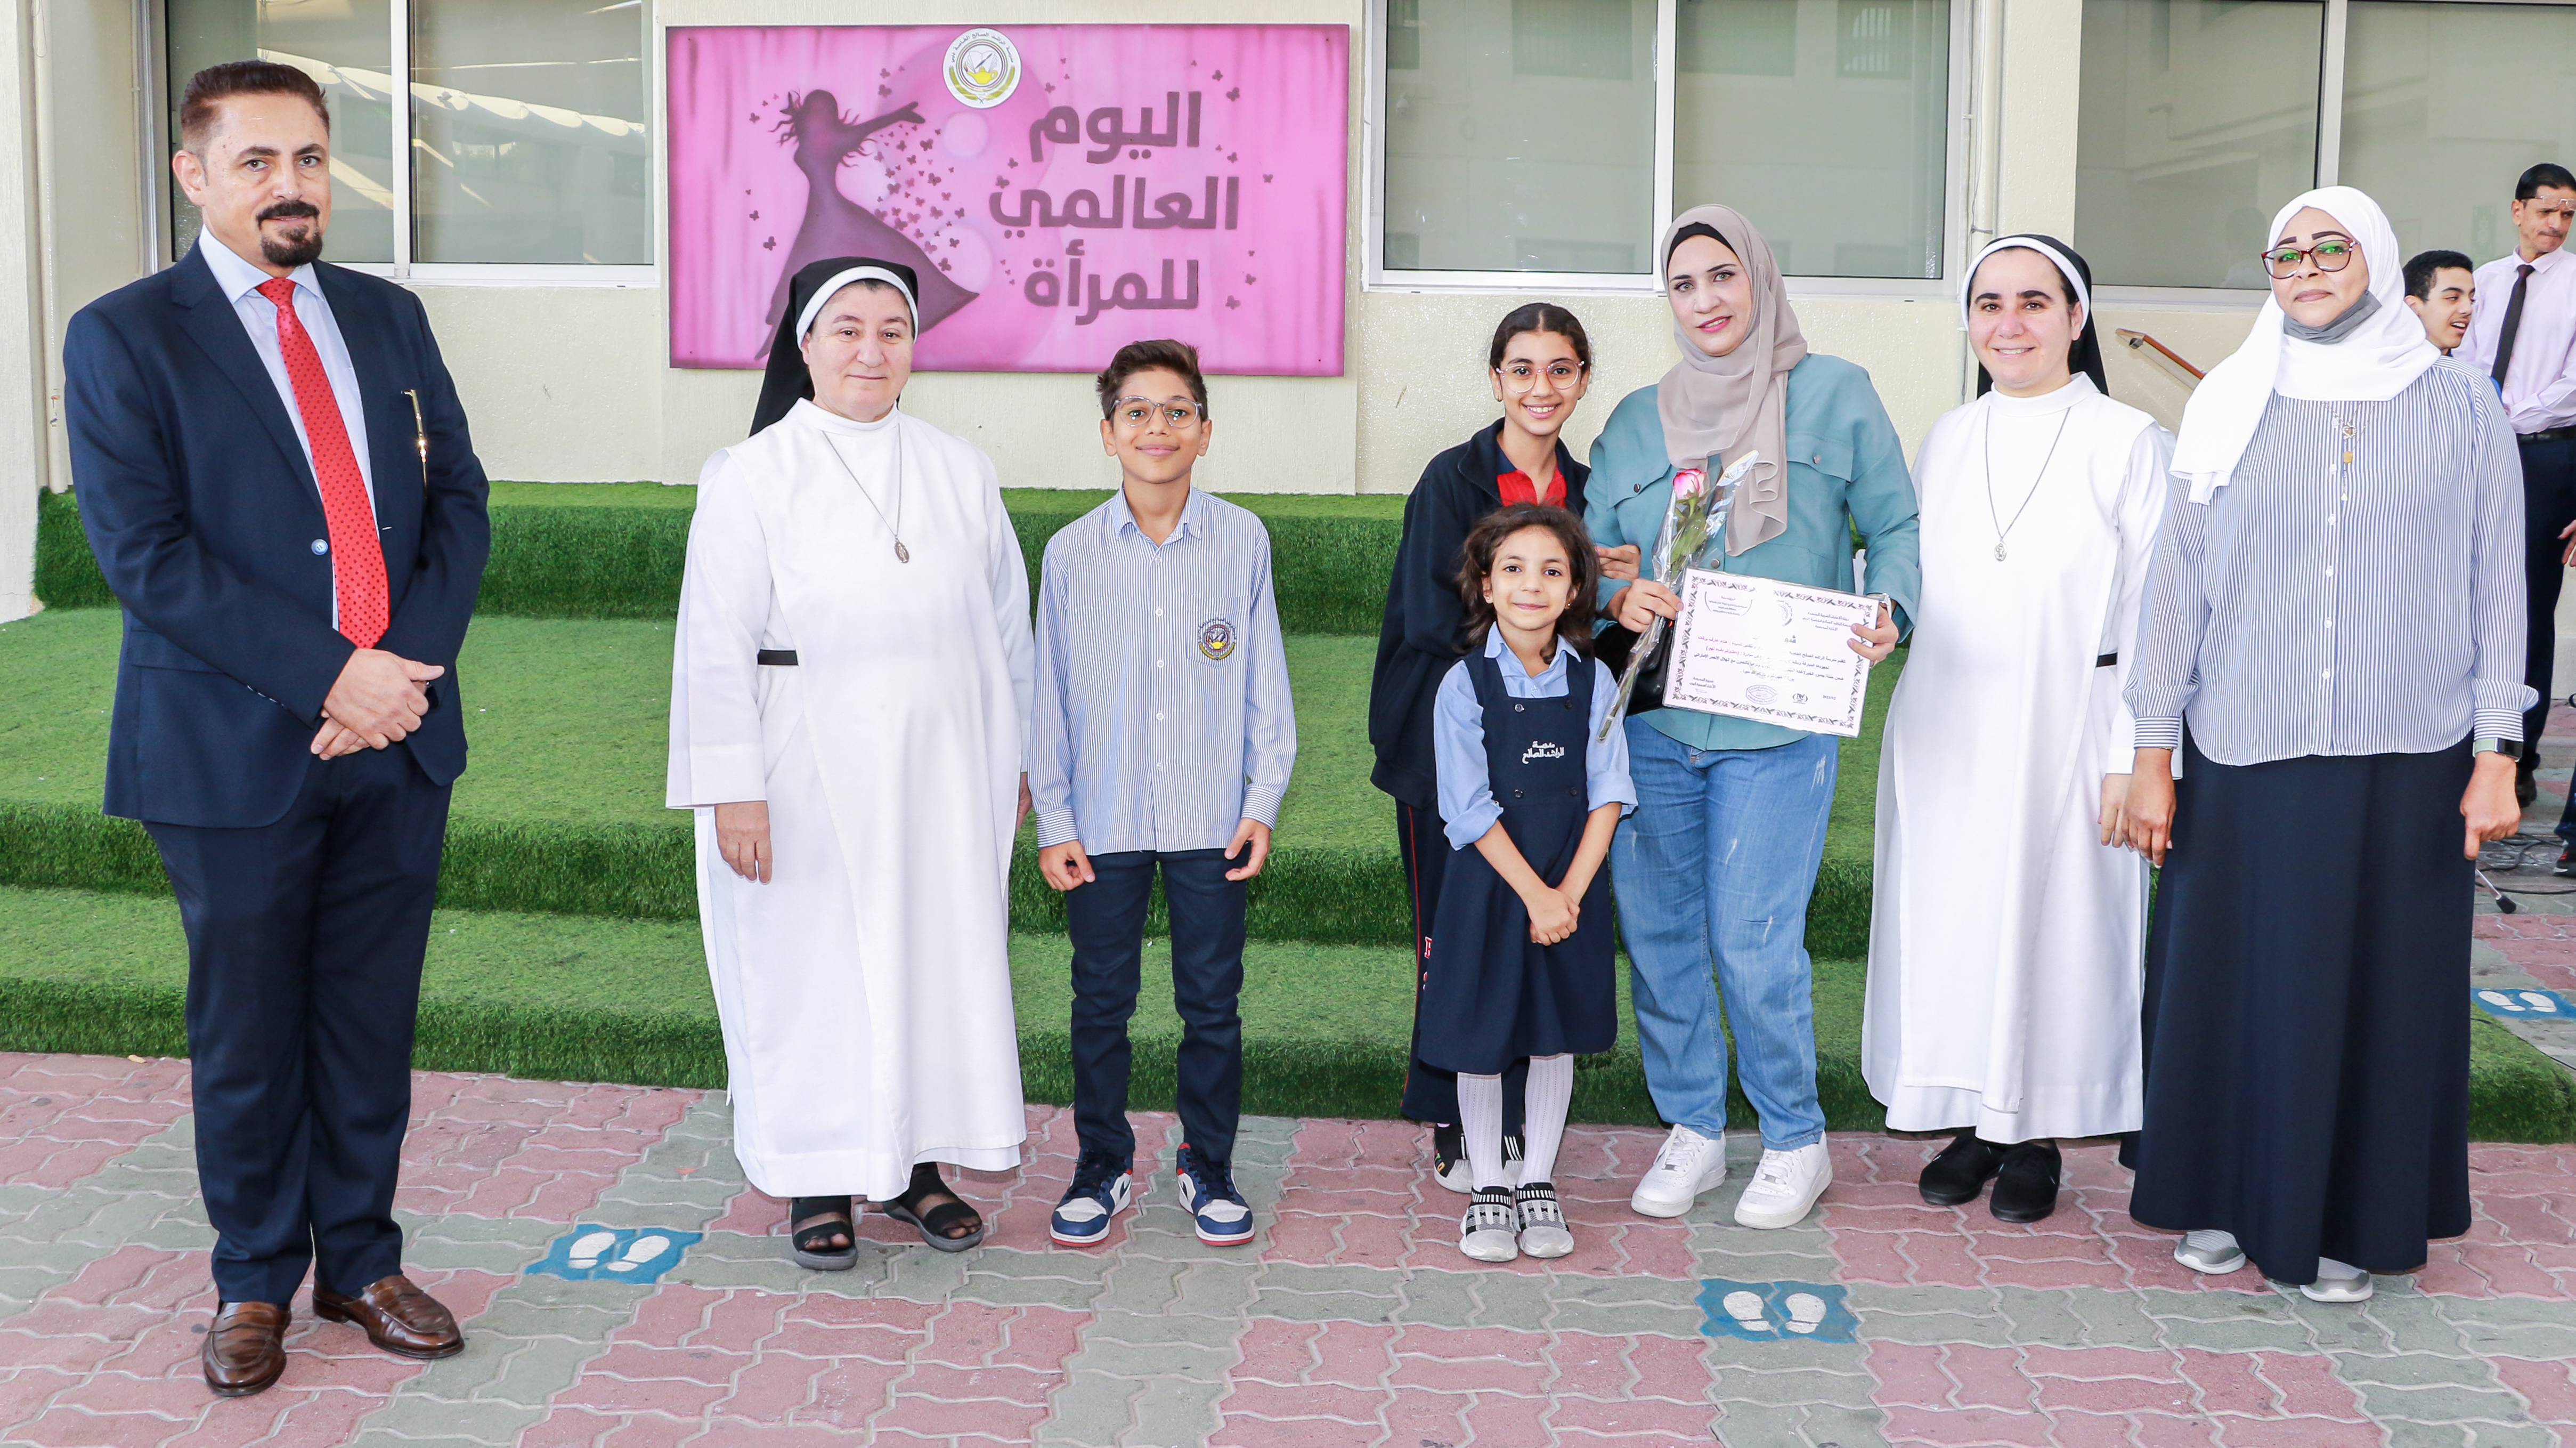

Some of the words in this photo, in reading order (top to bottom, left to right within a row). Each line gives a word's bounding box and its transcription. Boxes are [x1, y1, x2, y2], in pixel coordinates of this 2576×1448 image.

[1030, 92, 1201, 164] اليوم
[989, 174, 1239, 239] العالمي
[1024, 239, 1199, 325] للمرأة
